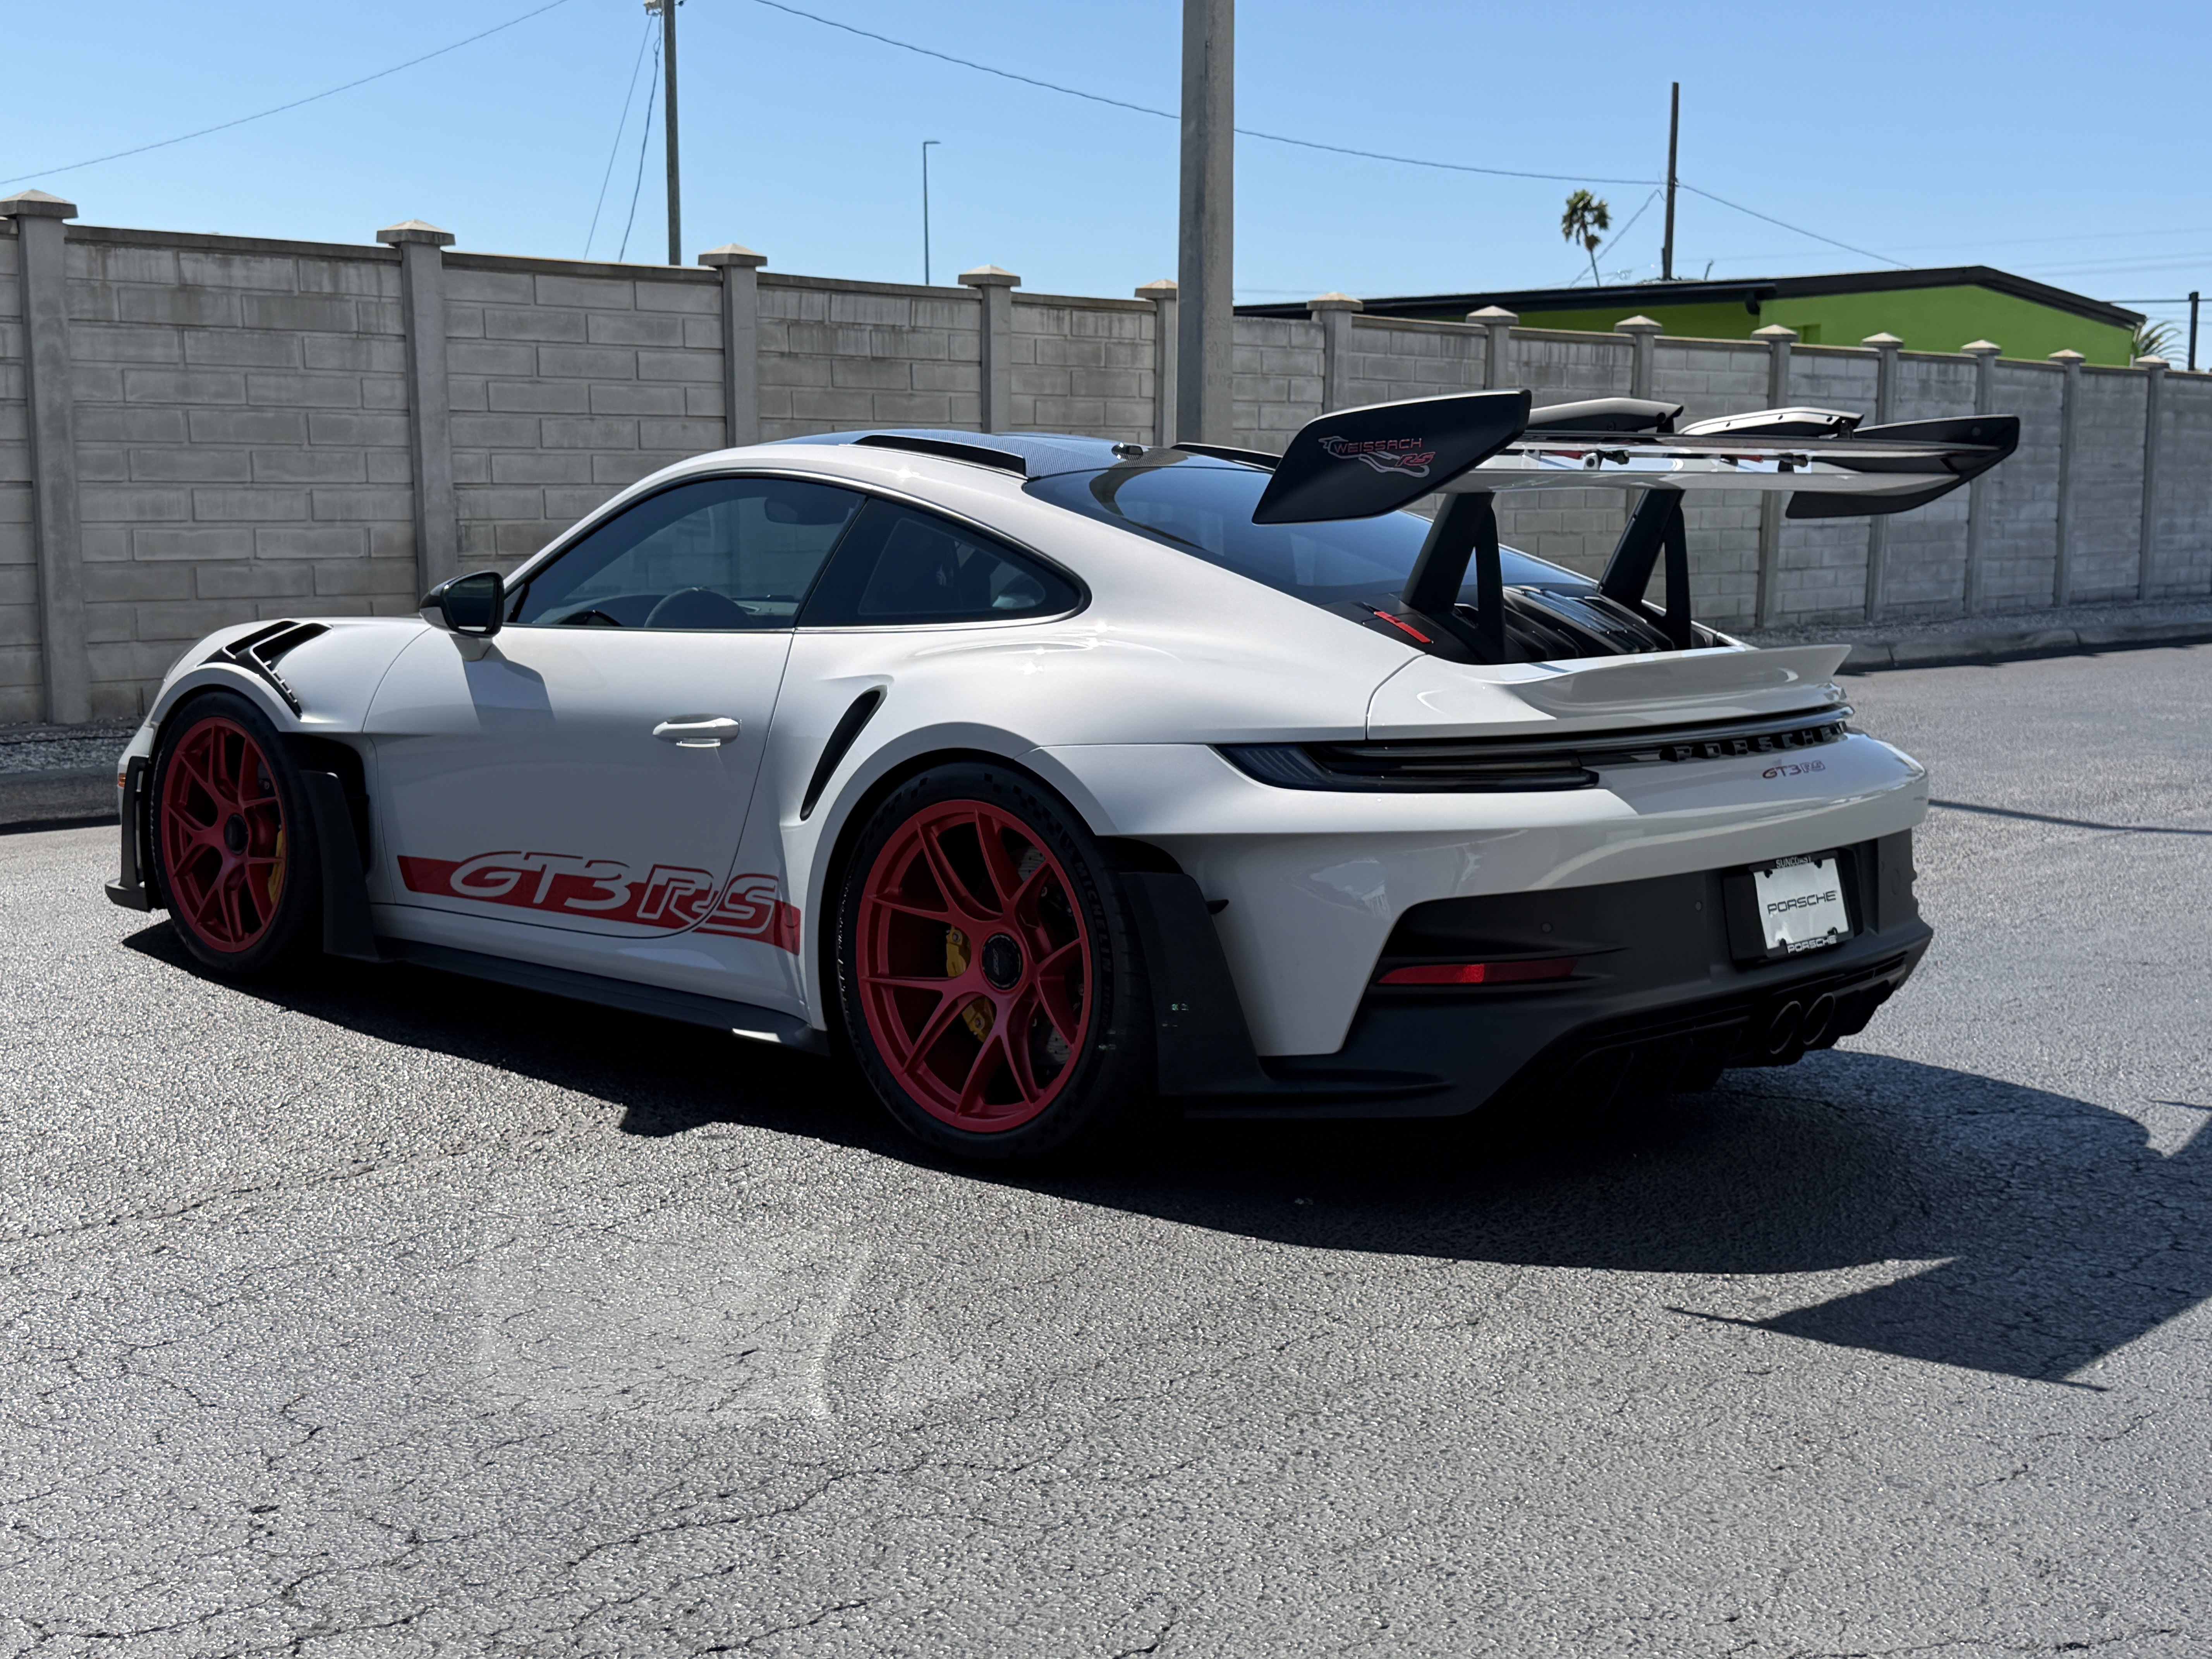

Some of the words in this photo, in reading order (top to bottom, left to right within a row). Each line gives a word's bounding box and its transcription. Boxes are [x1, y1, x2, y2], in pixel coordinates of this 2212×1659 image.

[1334, 438, 1422, 453] WEISSACH
[1395, 452, 1436, 467] RS
[1674, 727, 1833, 761] PORSCHE
[1767, 890, 1836, 914] PORSCHE
[1074, 860, 1112, 973] MICHELIN
[1787, 935, 1837, 954] PORSCHE
